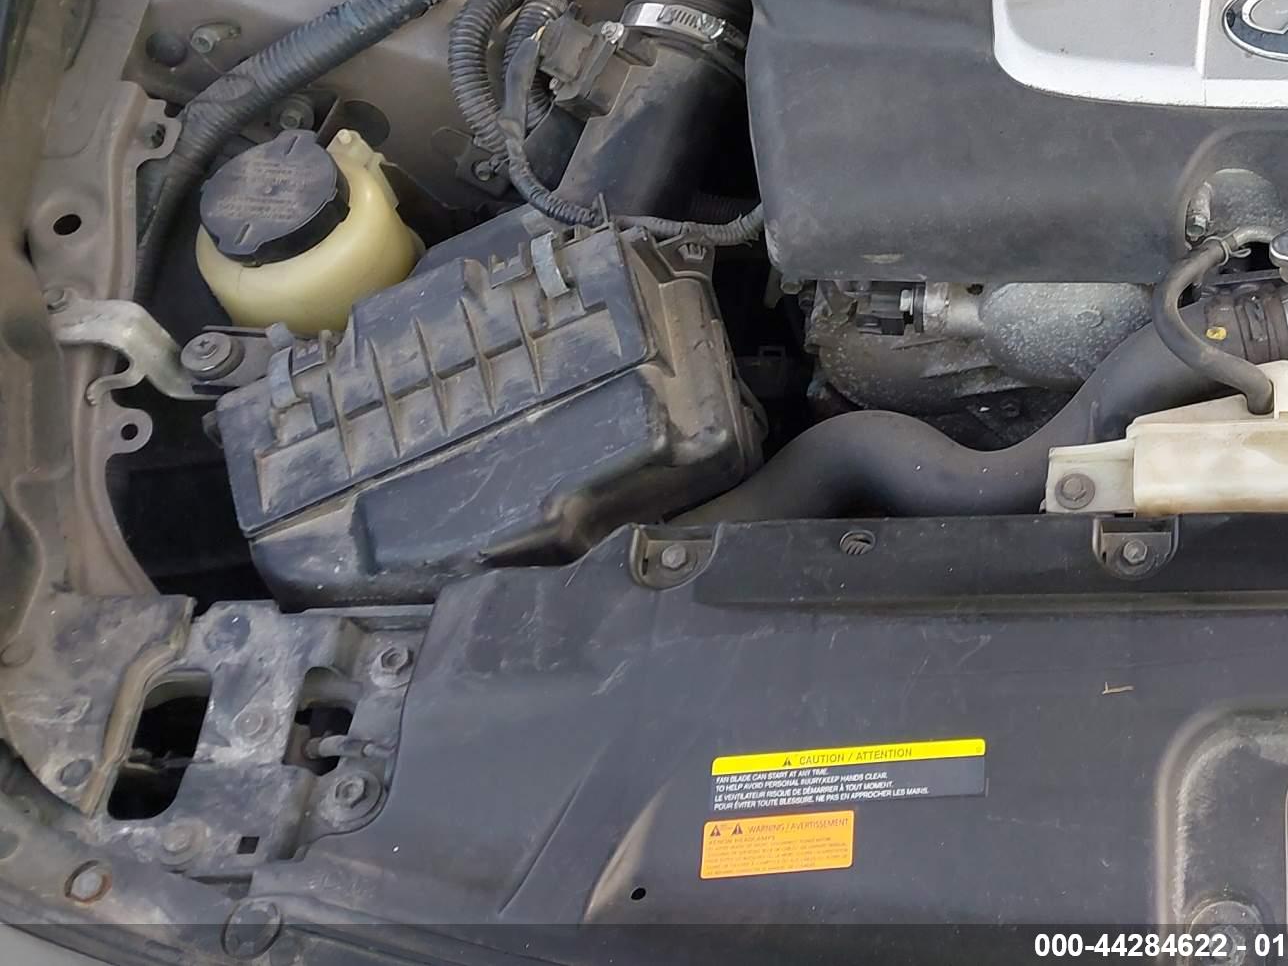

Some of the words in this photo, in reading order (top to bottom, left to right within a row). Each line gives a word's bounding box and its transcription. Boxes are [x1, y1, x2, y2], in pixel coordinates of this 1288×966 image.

[799, 753, 844, 765] CAUTION
[856, 748, 912, 761] ATTENTION
[725, 783, 743, 792] HELP
[743, 781, 763, 790] AVOID
[764, 779, 799, 789] PERSONAL
[840, 773, 863, 782] HANDS
[730, 774, 751, 782] BLADE
[752, 773, 767, 781] CAN
[768, 771, 787, 780] START
[788, 770, 797, 778] AT
[797, 769, 811, 777] ANY
[714, 802, 733, 810] POUR
[734, 800, 756, 810] ÉVITER
[757, 798, 779, 807] TOUTE
[826, 794, 840, 802] PAS
[850, 790, 892, 799] APPROCHER
[893, 789, 906, 797] LES
[715, 794, 723, 802] LE
[723, 791, 765, 801] VENTILATEUR
[766, 789, 792, 798] RISQUE
[793, 788, 801, 796] DE
[802, 785, 838, 795] DÉMARRER
[845, 782, 863, 791] TOUT
[749, 823, 785, 834] WARNING
[790, 818, 849, 831] AVERTISSEMENT
